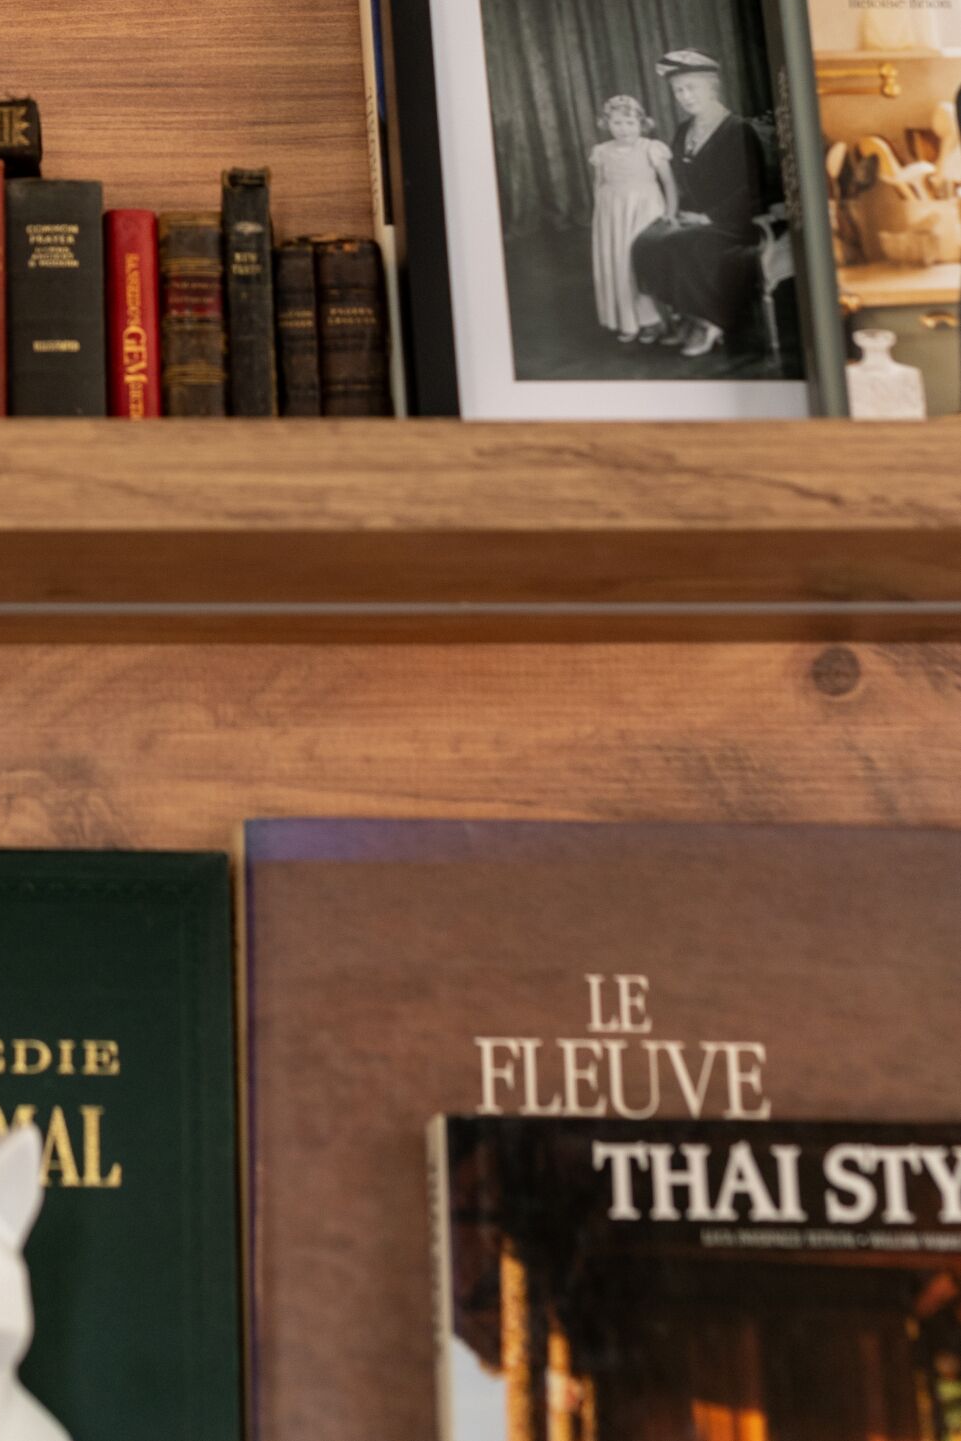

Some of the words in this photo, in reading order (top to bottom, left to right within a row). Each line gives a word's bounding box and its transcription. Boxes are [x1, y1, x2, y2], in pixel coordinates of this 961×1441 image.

[122, 325, 148, 383] GEM
[585, 973, 653, 1034] LE
[473, 1035, 772, 1121] FLEUVE
[591, 1138, 808, 1223] THAI
